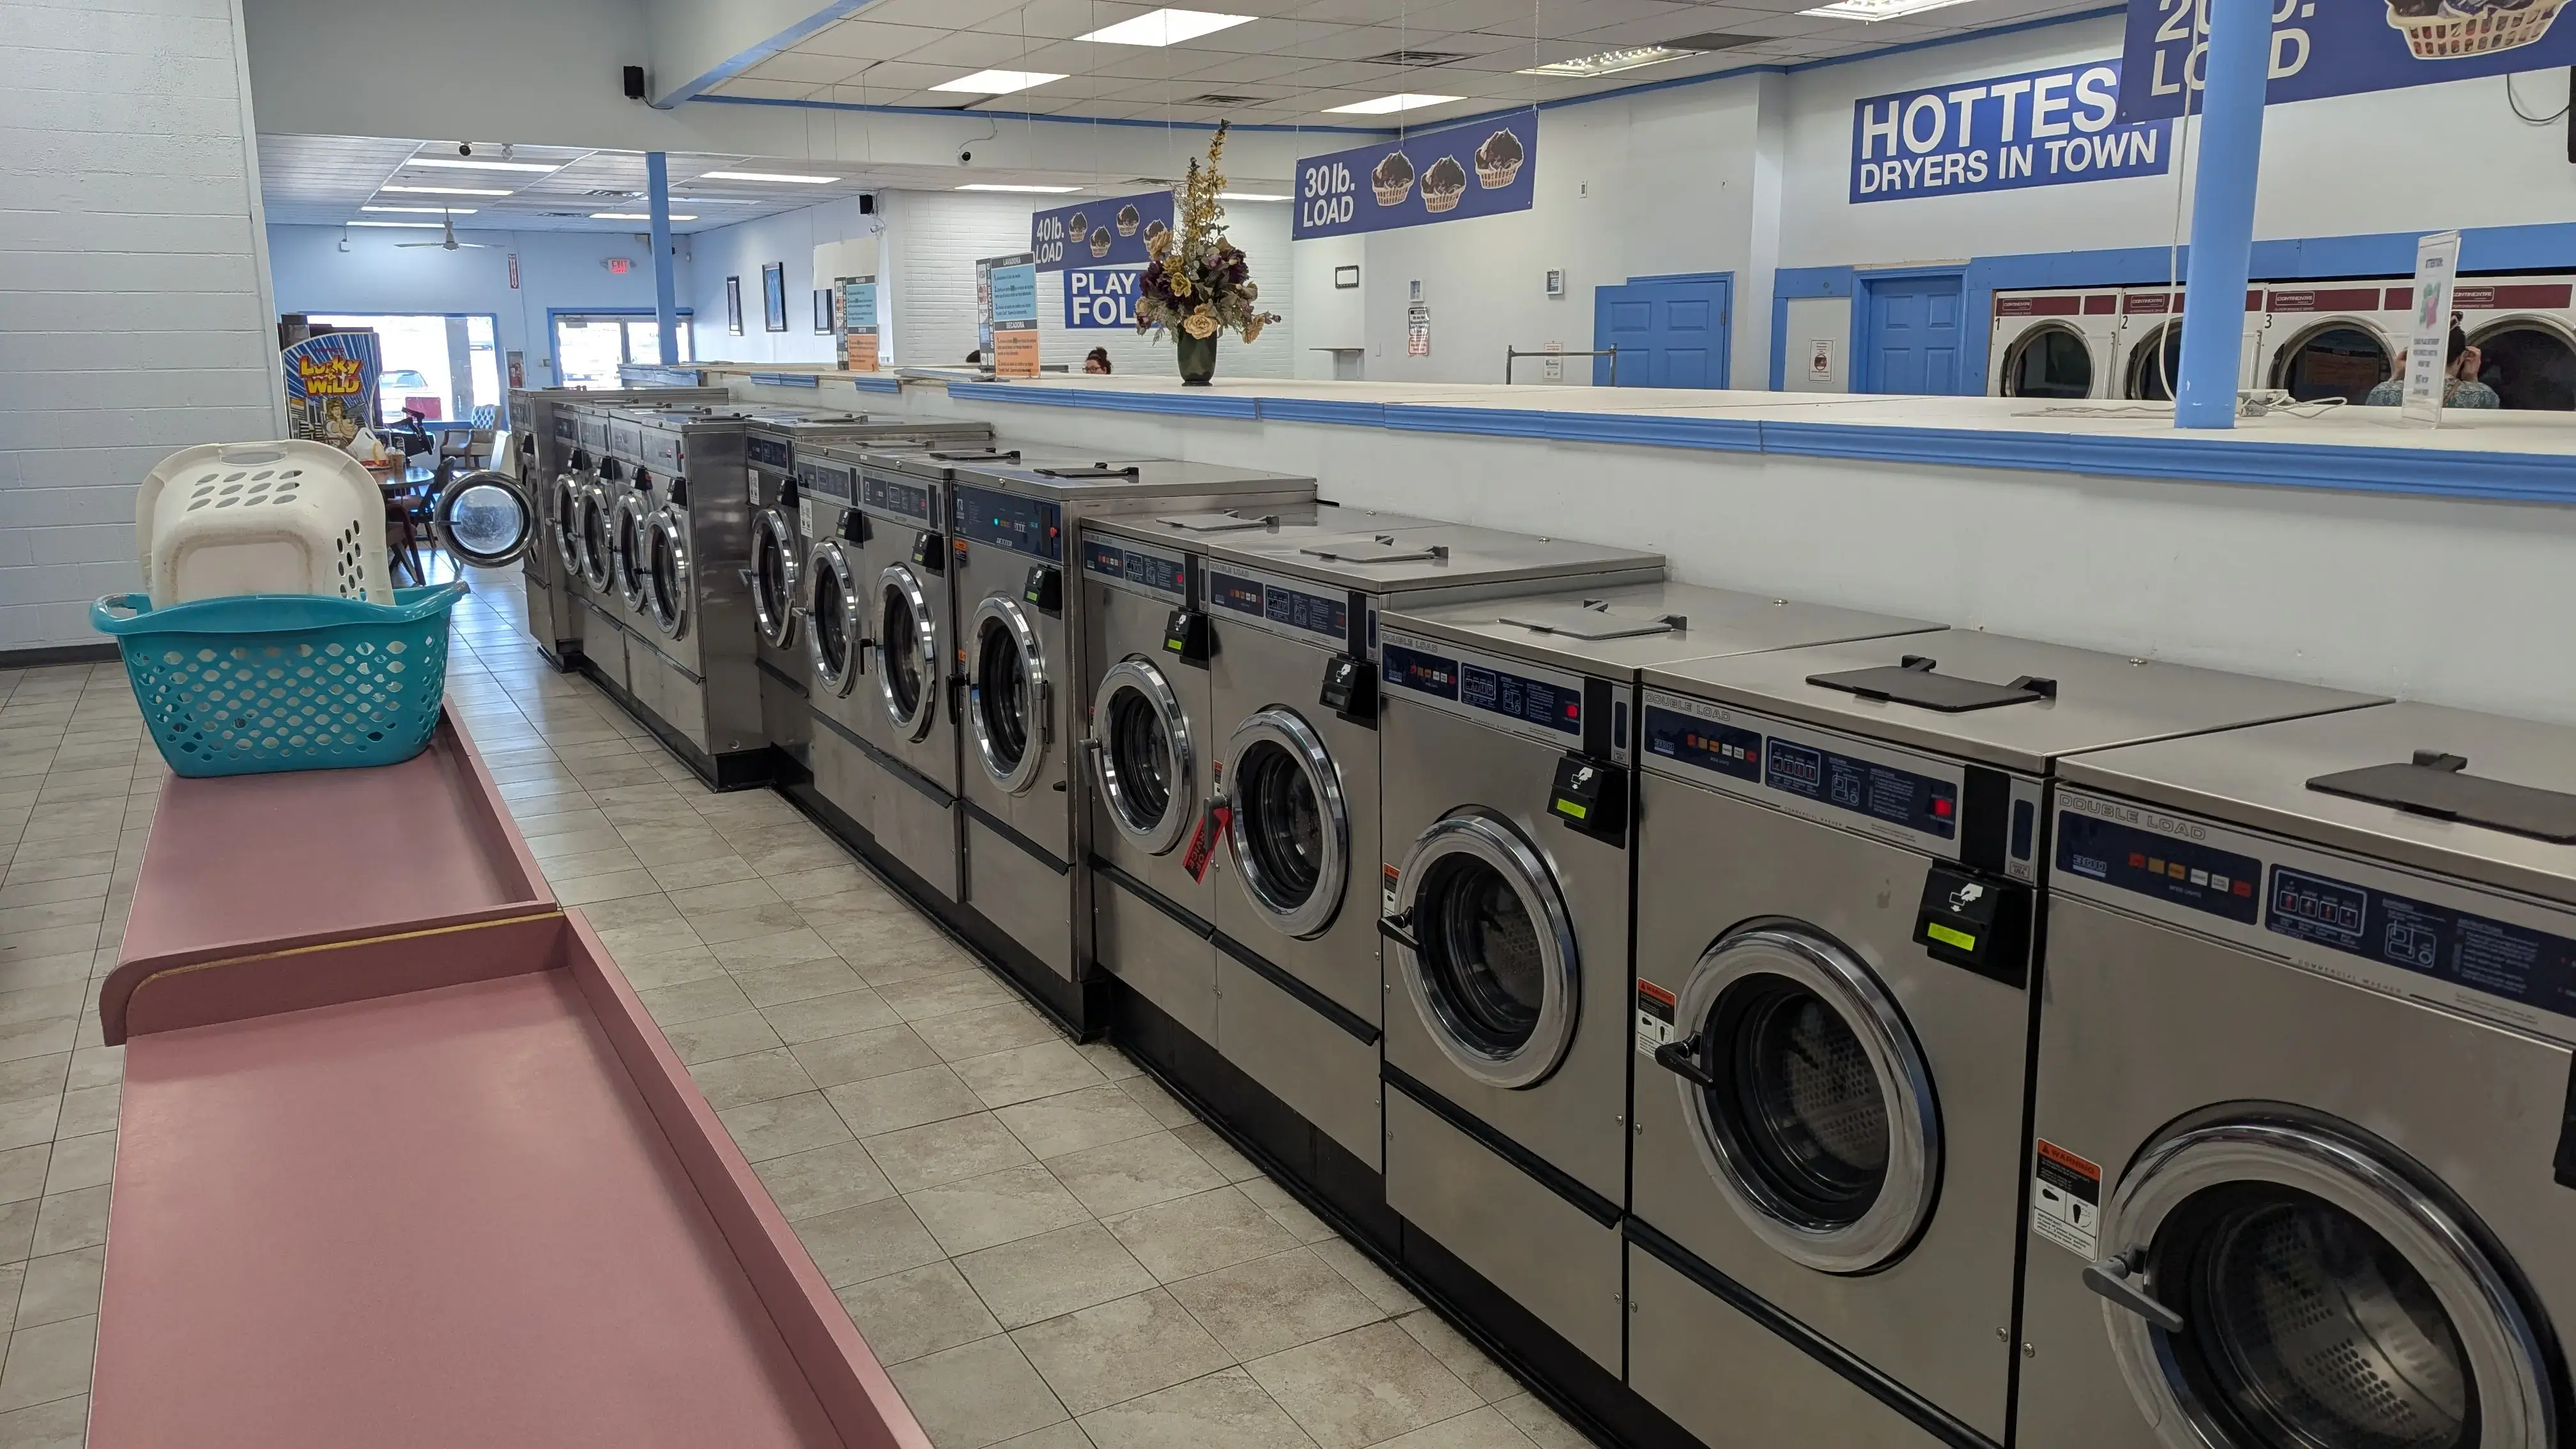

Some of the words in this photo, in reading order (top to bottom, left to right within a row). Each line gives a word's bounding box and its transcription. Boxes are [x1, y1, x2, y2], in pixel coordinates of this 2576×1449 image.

[2151, 28, 2310, 96] LOD
[1861, 66, 2131, 160] HOTTES
[1859, 150, 1988, 194] DRYERS
[1998, 144, 2034, 180] IN
[2044, 128, 2157, 174] TOWN
[1303, 195, 1354, 227] LOAD
[1036, 241, 1063, 264] LOAD
[1071, 273, 1137, 295] PLAY
[1073, 296, 1137, 325] FOL
[2121, 316, 2128, 330] 2
[2264, 314, 2273, 329] 3
[1995, 318, 2000, 330] 1
[1382, 632, 1413, 647] DOUBLE
[1415, 640, 1438, 653] LOAD
[1645, 693, 1692, 712] DOUBLE
[1696, 705, 1730, 721] LOAD
[1784, 806, 1817, 820] COMMERCIAL
[2059, 793, 2139, 824] DOUBLE
[2147, 815, 2205, 840] LOAD
[1188, 829, 1206, 869] RVICE
[2073, 854, 2107, 872] 300
[2298, 960, 2356, 981] COMMERCIAL
[2051, 1149, 2094, 1176] WARNING
